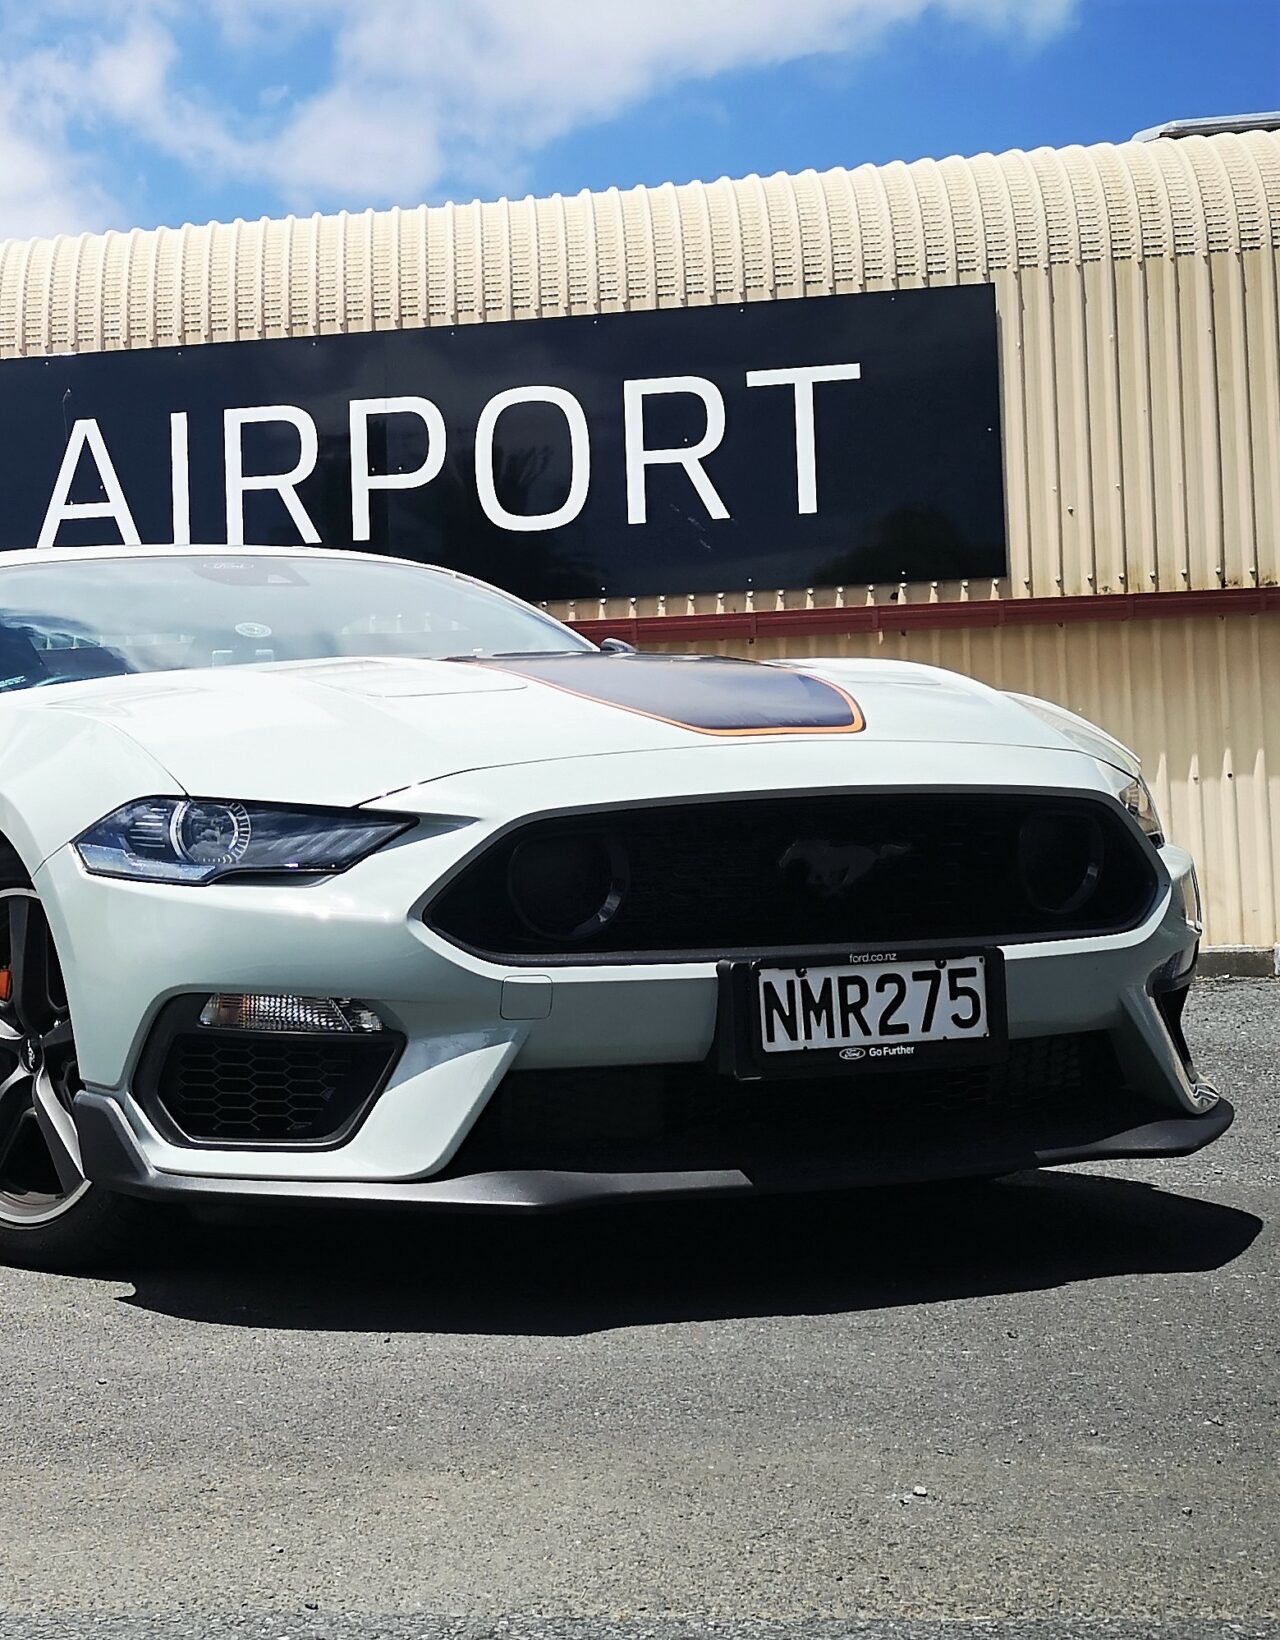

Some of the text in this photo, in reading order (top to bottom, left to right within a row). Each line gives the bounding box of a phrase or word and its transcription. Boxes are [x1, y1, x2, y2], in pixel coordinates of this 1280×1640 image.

[37, 363, 861, 548] AIRPORT
[849, 953, 897, 964] ford.co.nz
[763, 967, 982, 1043] NMR275
[869, 1047, 882, 1057] Go
[883, 1045, 915, 1056] Further
